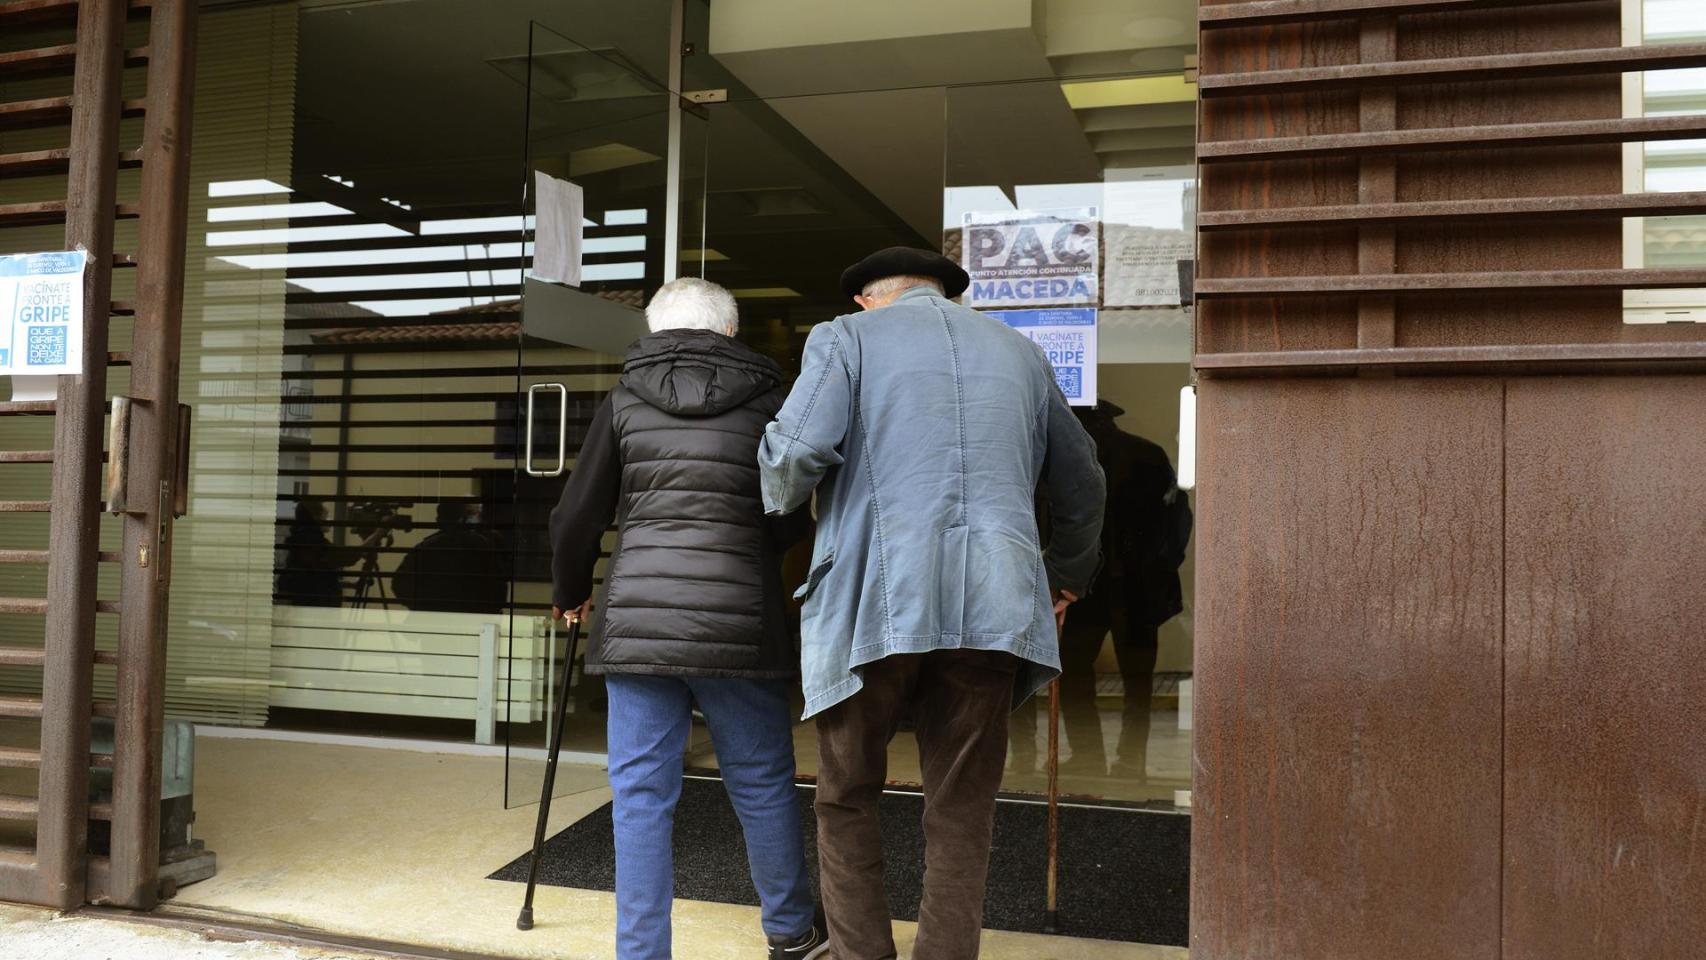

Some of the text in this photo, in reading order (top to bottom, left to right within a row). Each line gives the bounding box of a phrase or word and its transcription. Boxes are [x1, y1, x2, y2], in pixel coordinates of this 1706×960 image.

[968, 223, 1092, 272] PAC
[970, 266, 1092, 278] PUNTO ATENCIÓN CONTINUADA
[972, 278, 1091, 301] MACEDA
[22, 294, 63, 305] FRONTE
[20, 306, 70, 323] GRIPE
[30, 327, 65, 336] QUE A
[1037, 331, 1084, 341] VACÍNATE
[30, 335, 65, 344] GRIPE
[30, 350, 65, 358] DEIXE
[1048, 350, 1084, 364] RIPE
[1053, 367, 1067, 375] UE
